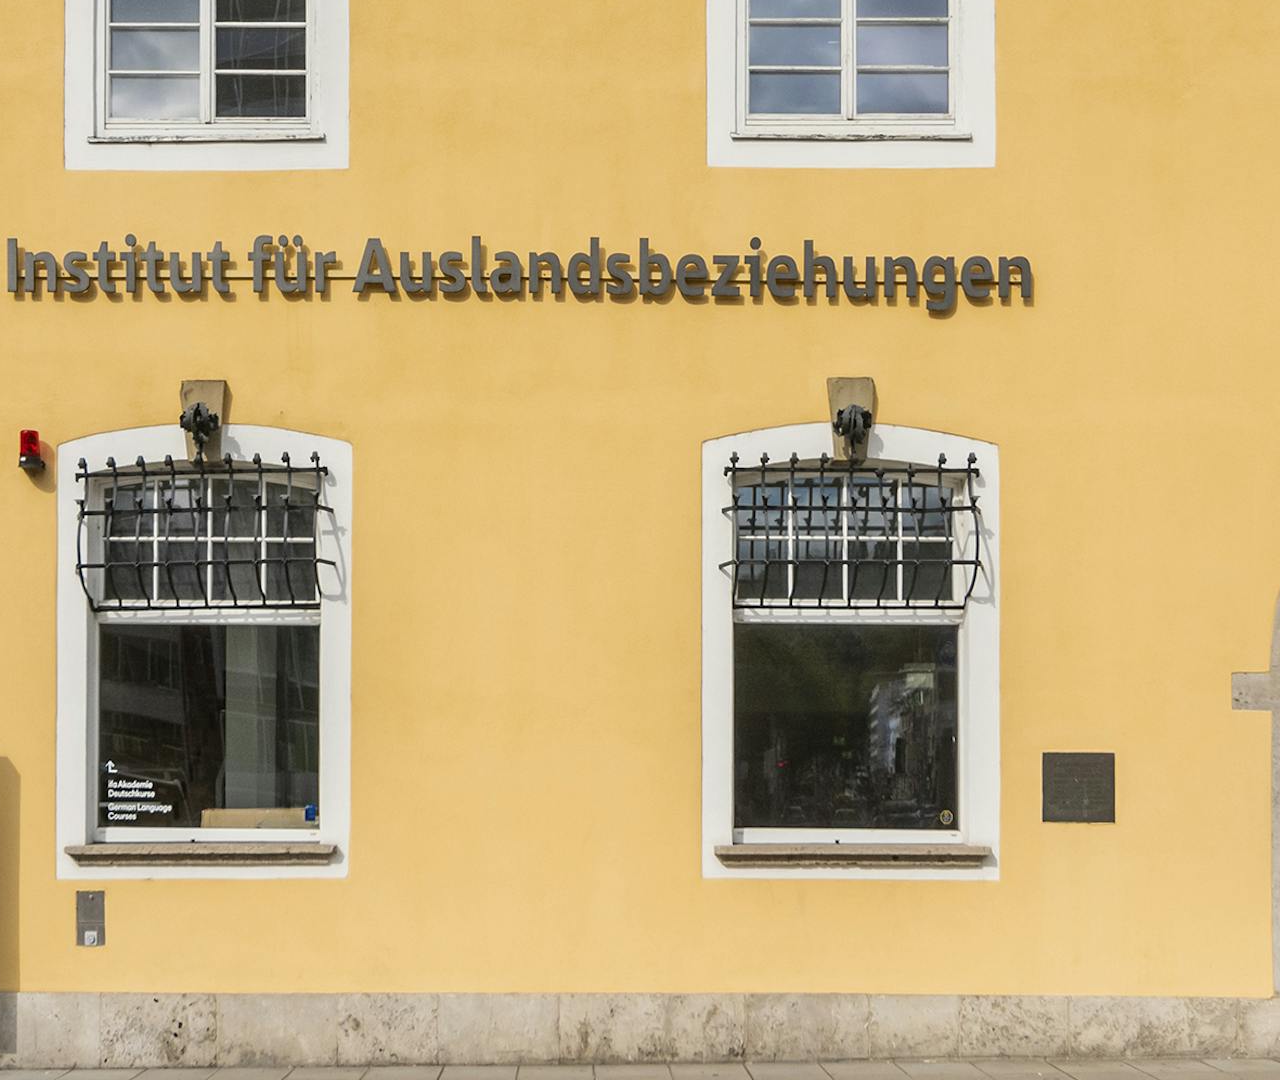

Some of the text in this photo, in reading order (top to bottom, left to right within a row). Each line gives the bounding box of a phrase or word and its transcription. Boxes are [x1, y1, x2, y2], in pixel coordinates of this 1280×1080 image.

[6, 233, 1033, 312] Institut für Auslandsbeziehungen
[117, 779, 154, 789] Akademie
[107, 803, 173, 813] German Language
[107, 812, 137, 820] Courses
